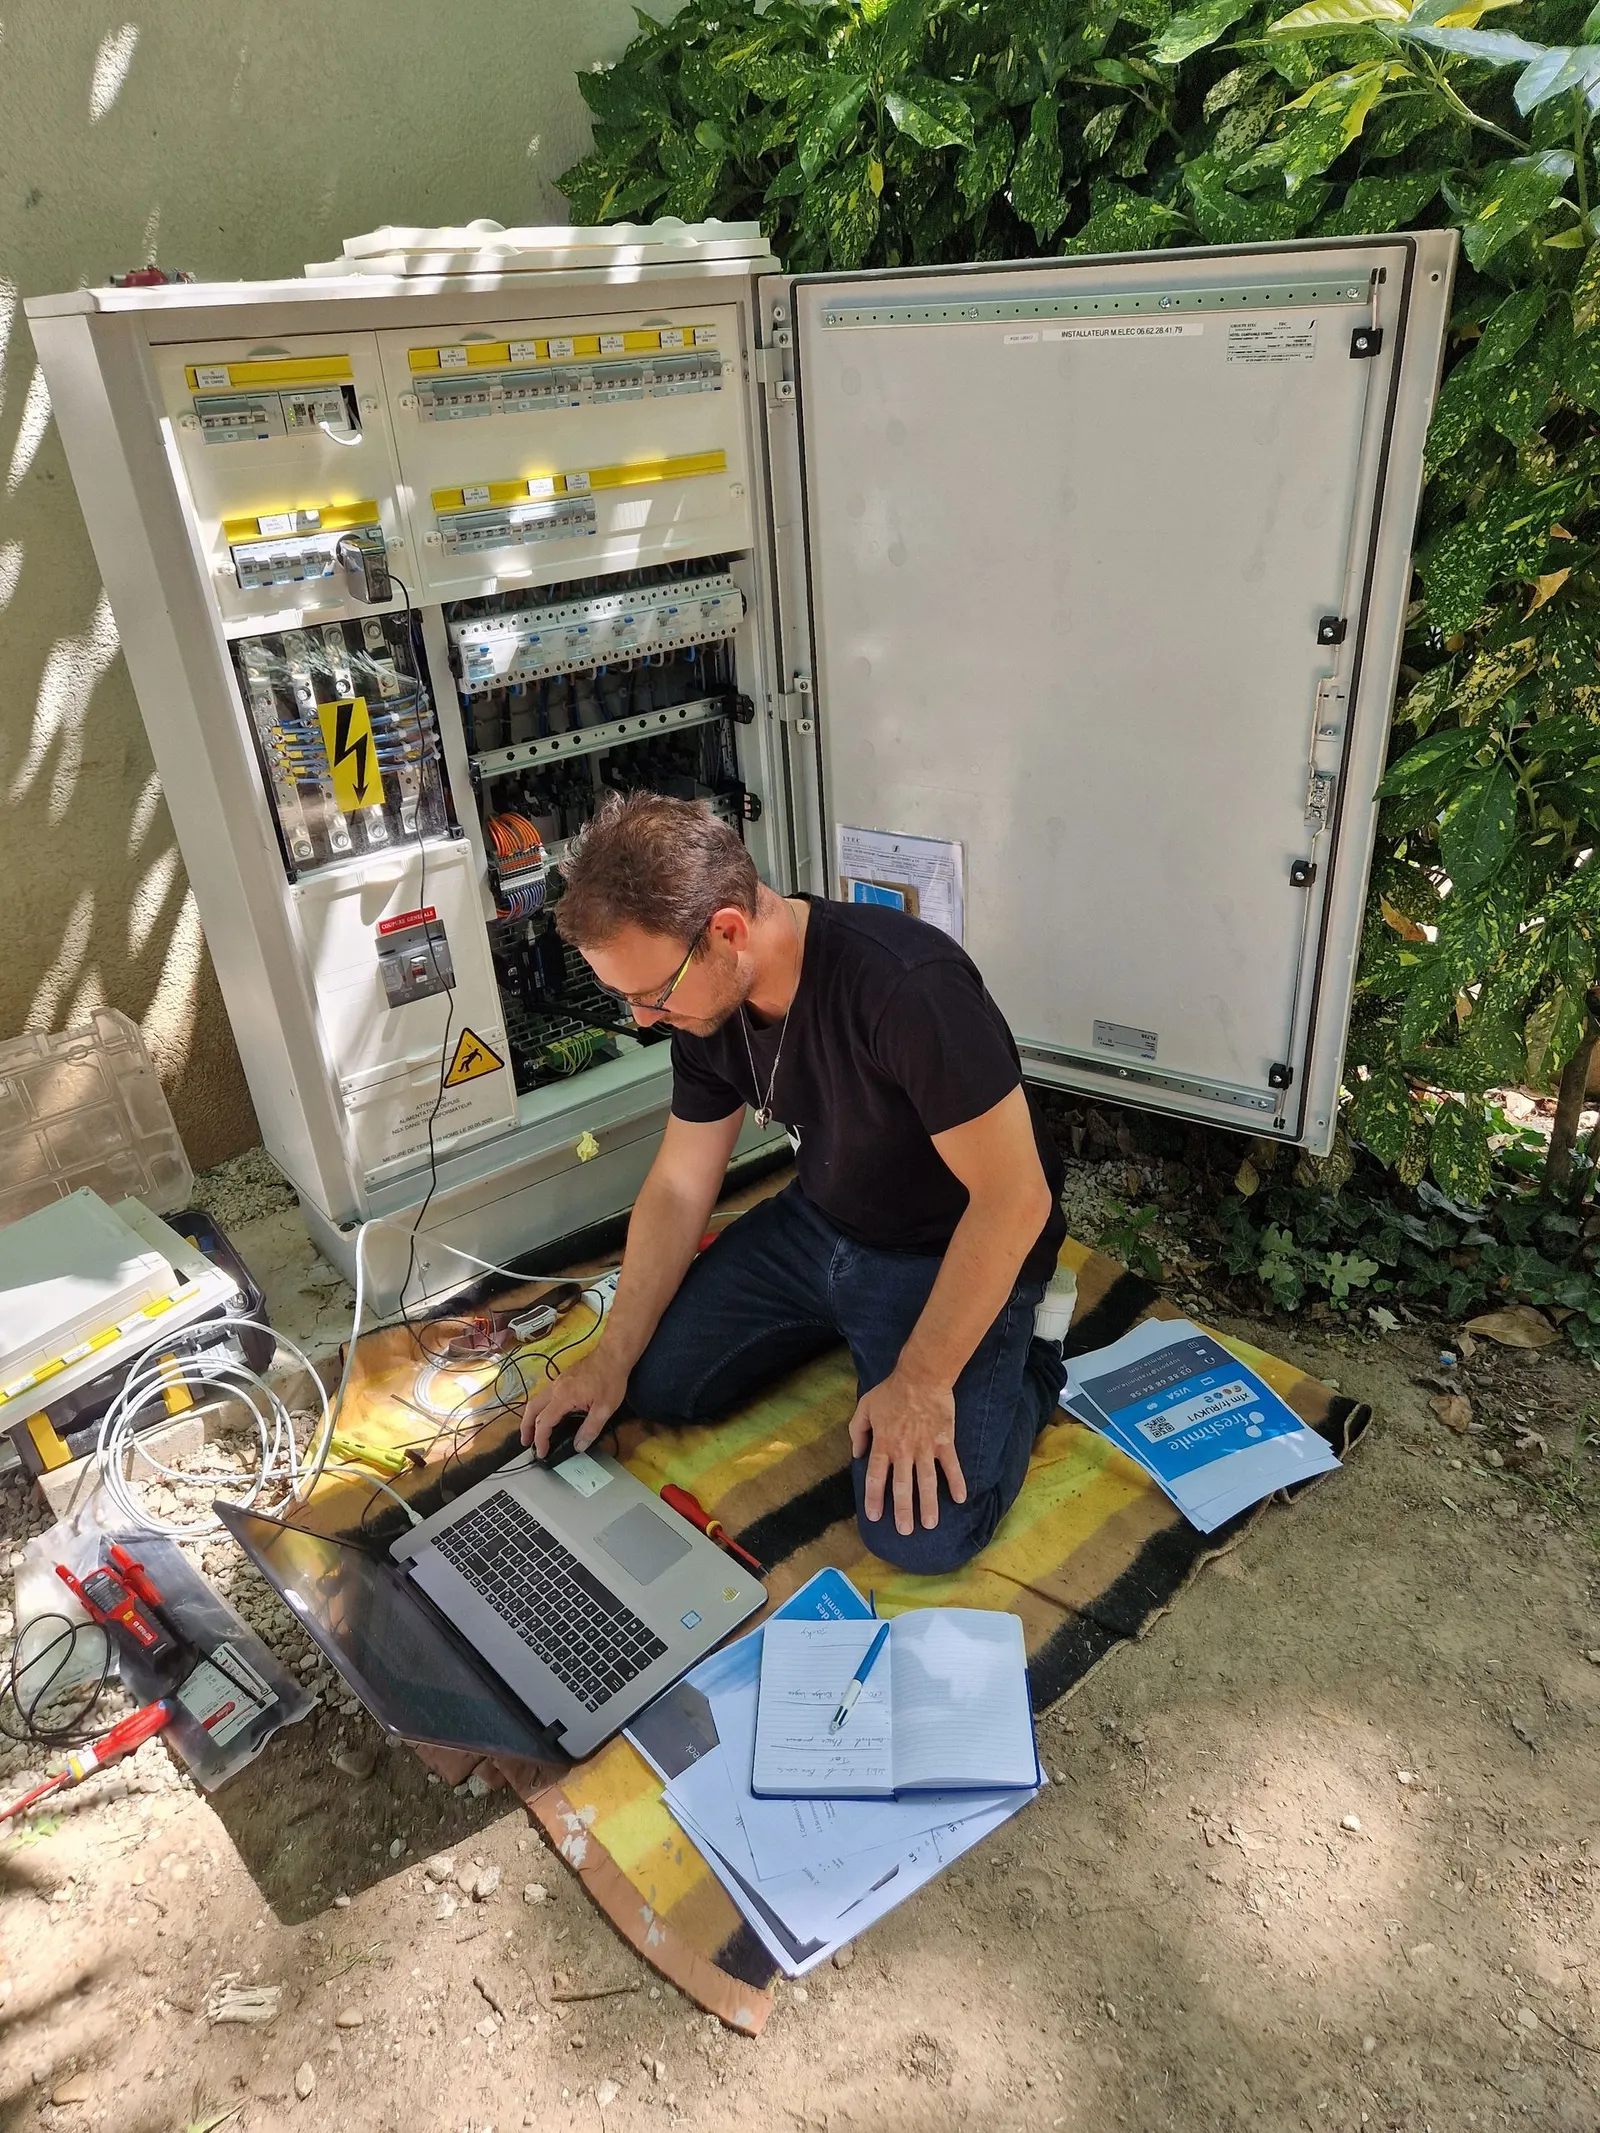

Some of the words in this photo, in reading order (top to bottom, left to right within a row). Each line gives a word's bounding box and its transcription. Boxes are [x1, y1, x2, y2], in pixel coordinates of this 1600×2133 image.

[1061, 329, 1109, 338] INSTALLATEUR
[381, 917, 405, 930] COUPURE
[407, 911, 434, 922] GENEALE
[399, 1106, 438, 1124] ALIMENTATIO
[1106, 1358, 1181, 1393] support@freshmile.com
[1166, 1372, 1180, 1383] 88
[1179, 1366, 1193, 1376] 03
[1129, 1389, 1142, 1399] 58
[1166, 1386, 1192, 1400] VISA
[1170, 1411, 1248, 1451] freshmile
[815, 1602, 830, 1620] des
[821, 1592, 846, 1620] nomie
